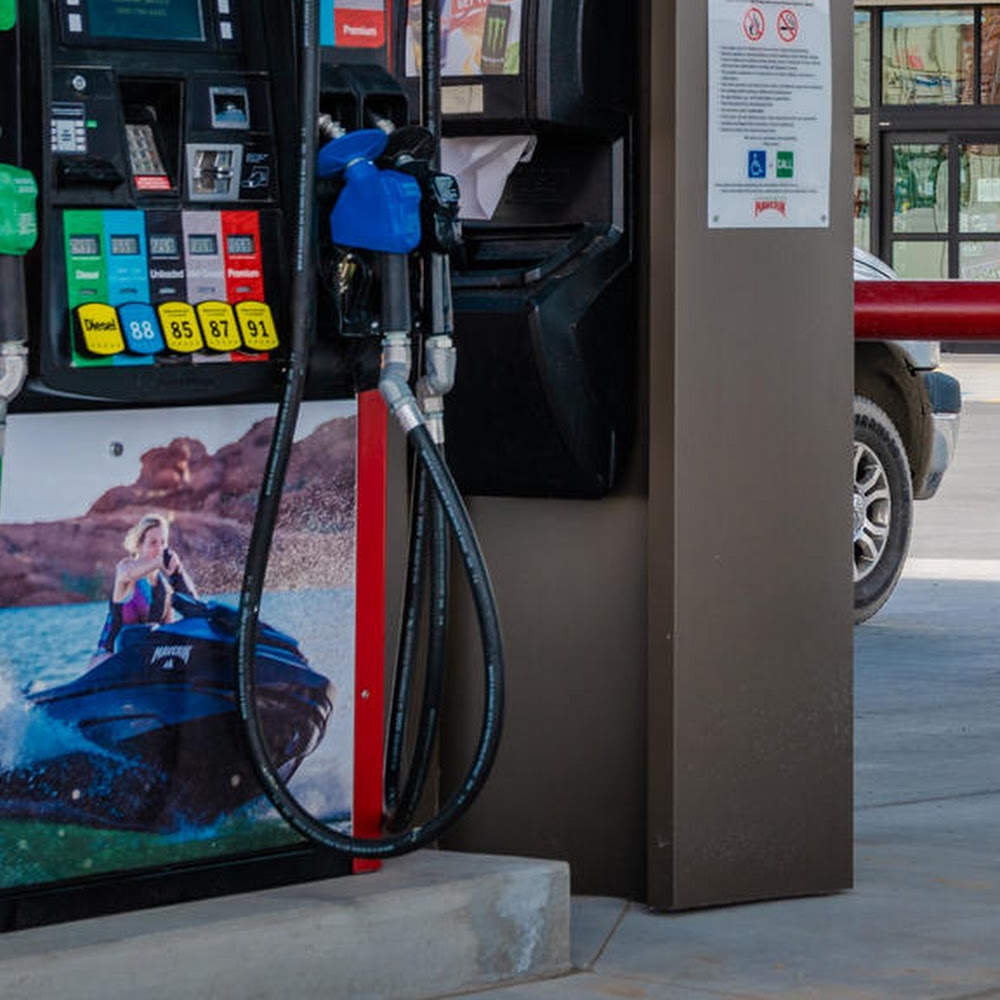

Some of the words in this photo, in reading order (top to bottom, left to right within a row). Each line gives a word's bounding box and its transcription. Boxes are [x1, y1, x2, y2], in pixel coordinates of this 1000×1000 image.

[84, 319, 118, 332] Diesel
[129, 321, 155, 340] 88
[170, 321, 194, 339] 85
[209, 320, 229, 338] 87
[247, 320, 270, 338] 91
